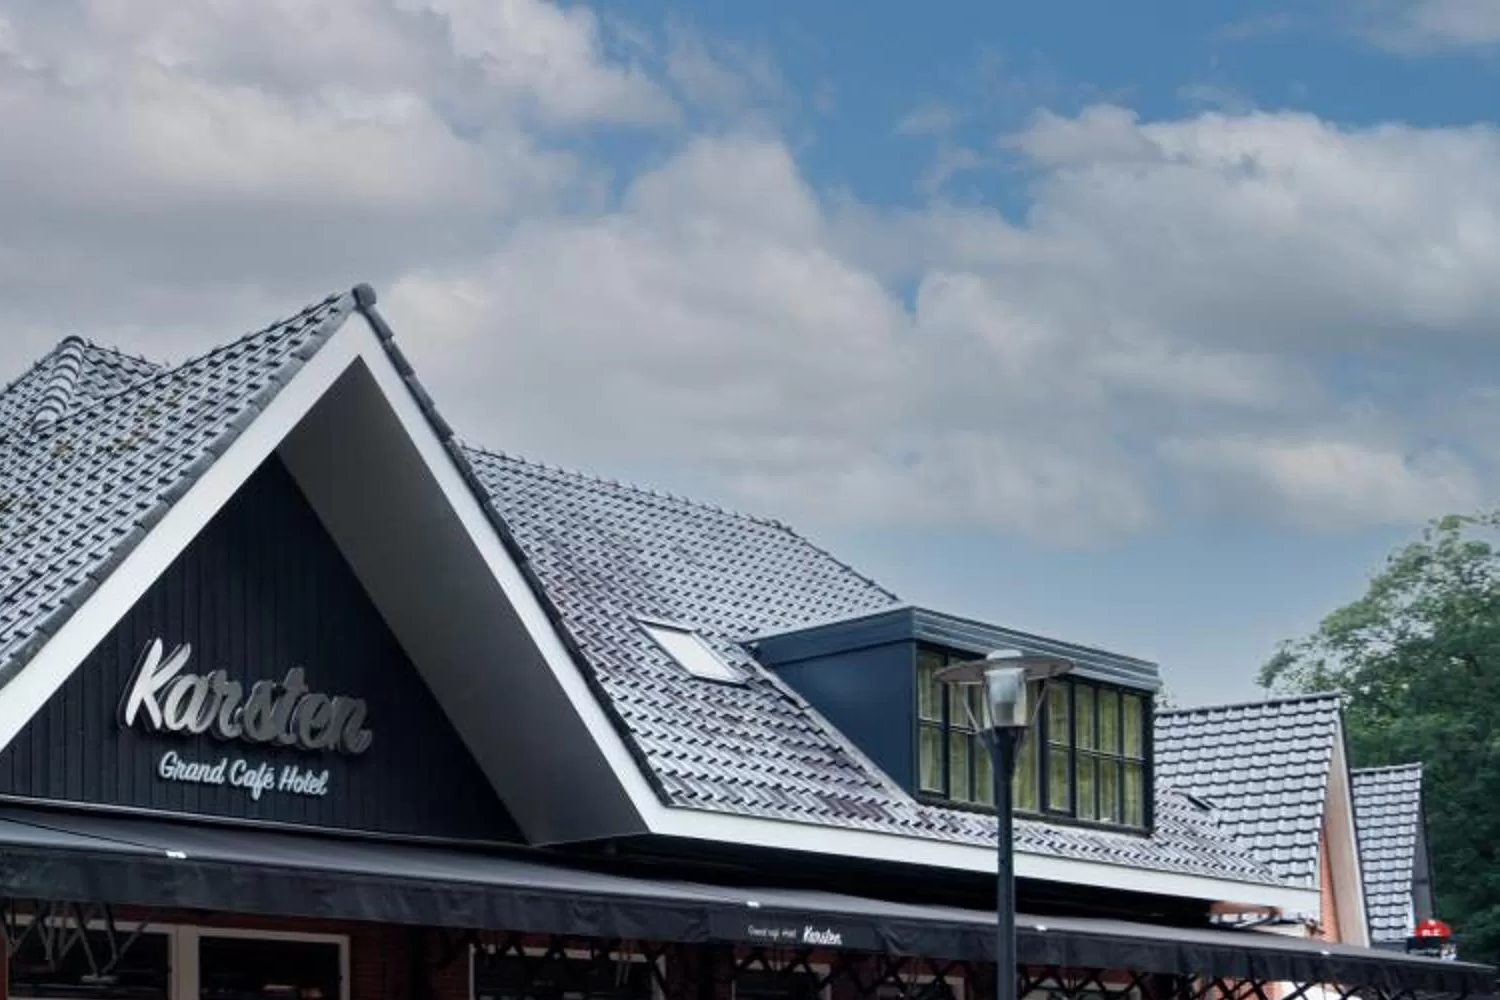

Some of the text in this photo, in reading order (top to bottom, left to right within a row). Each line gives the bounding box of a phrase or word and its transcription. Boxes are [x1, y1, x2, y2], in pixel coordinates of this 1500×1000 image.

[118, 637, 373, 754] Karsten
[159, 751, 328, 800] Grand Café Hotel
